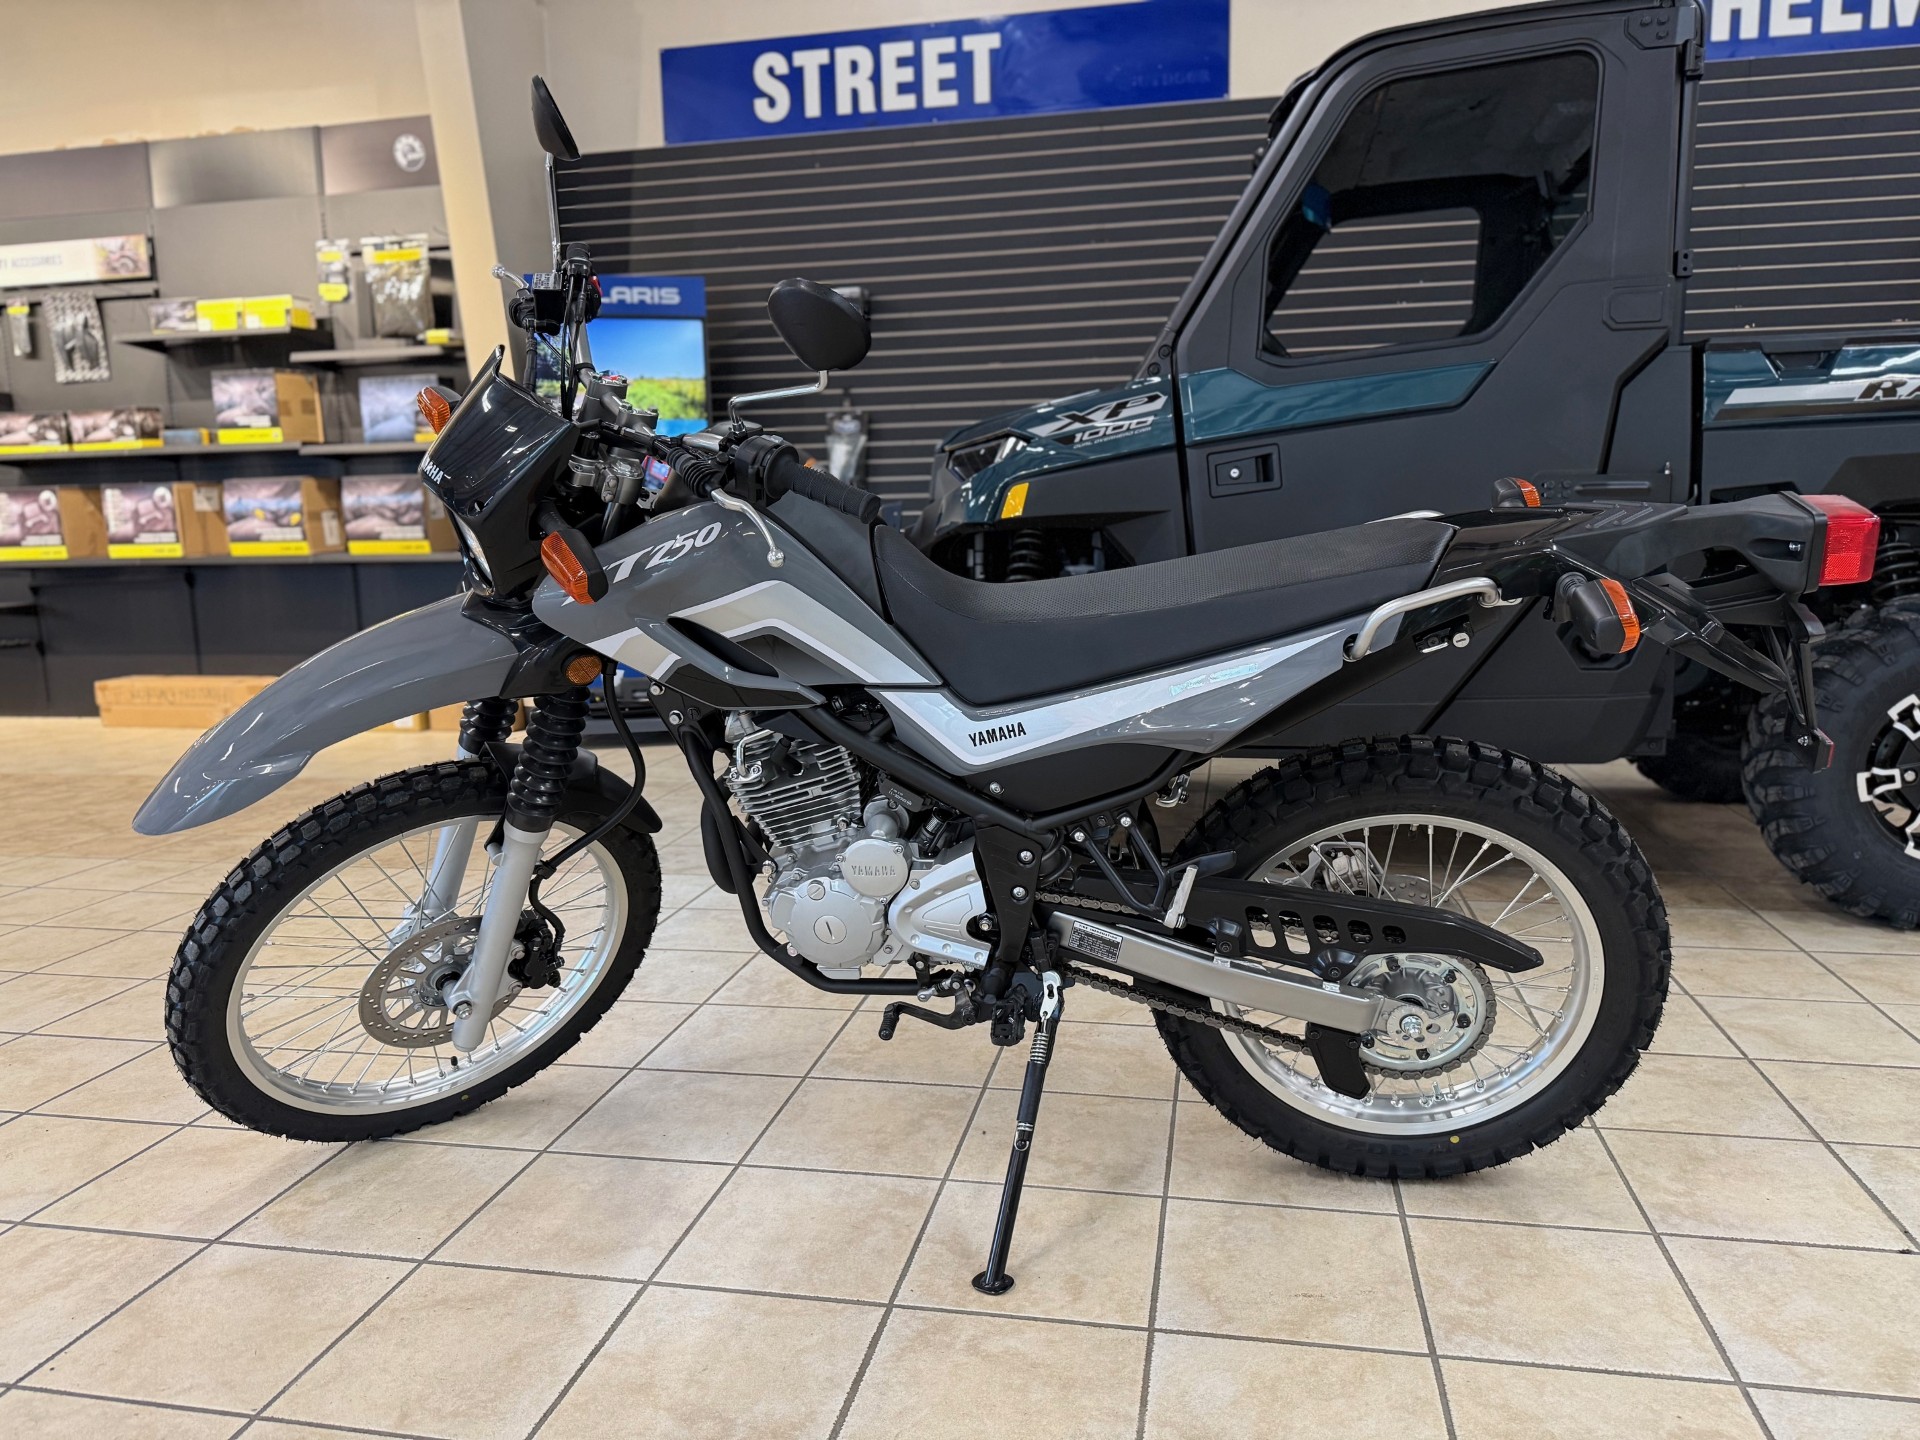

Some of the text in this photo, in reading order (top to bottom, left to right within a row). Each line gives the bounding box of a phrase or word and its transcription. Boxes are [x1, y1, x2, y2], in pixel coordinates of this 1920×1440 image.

[752, 32, 1001, 124] STREET
[1073, 416, 1154, 443] 1000
[968, 721, 1027, 747] YAMAHA
[851, 865, 896, 877] YAMAHA
